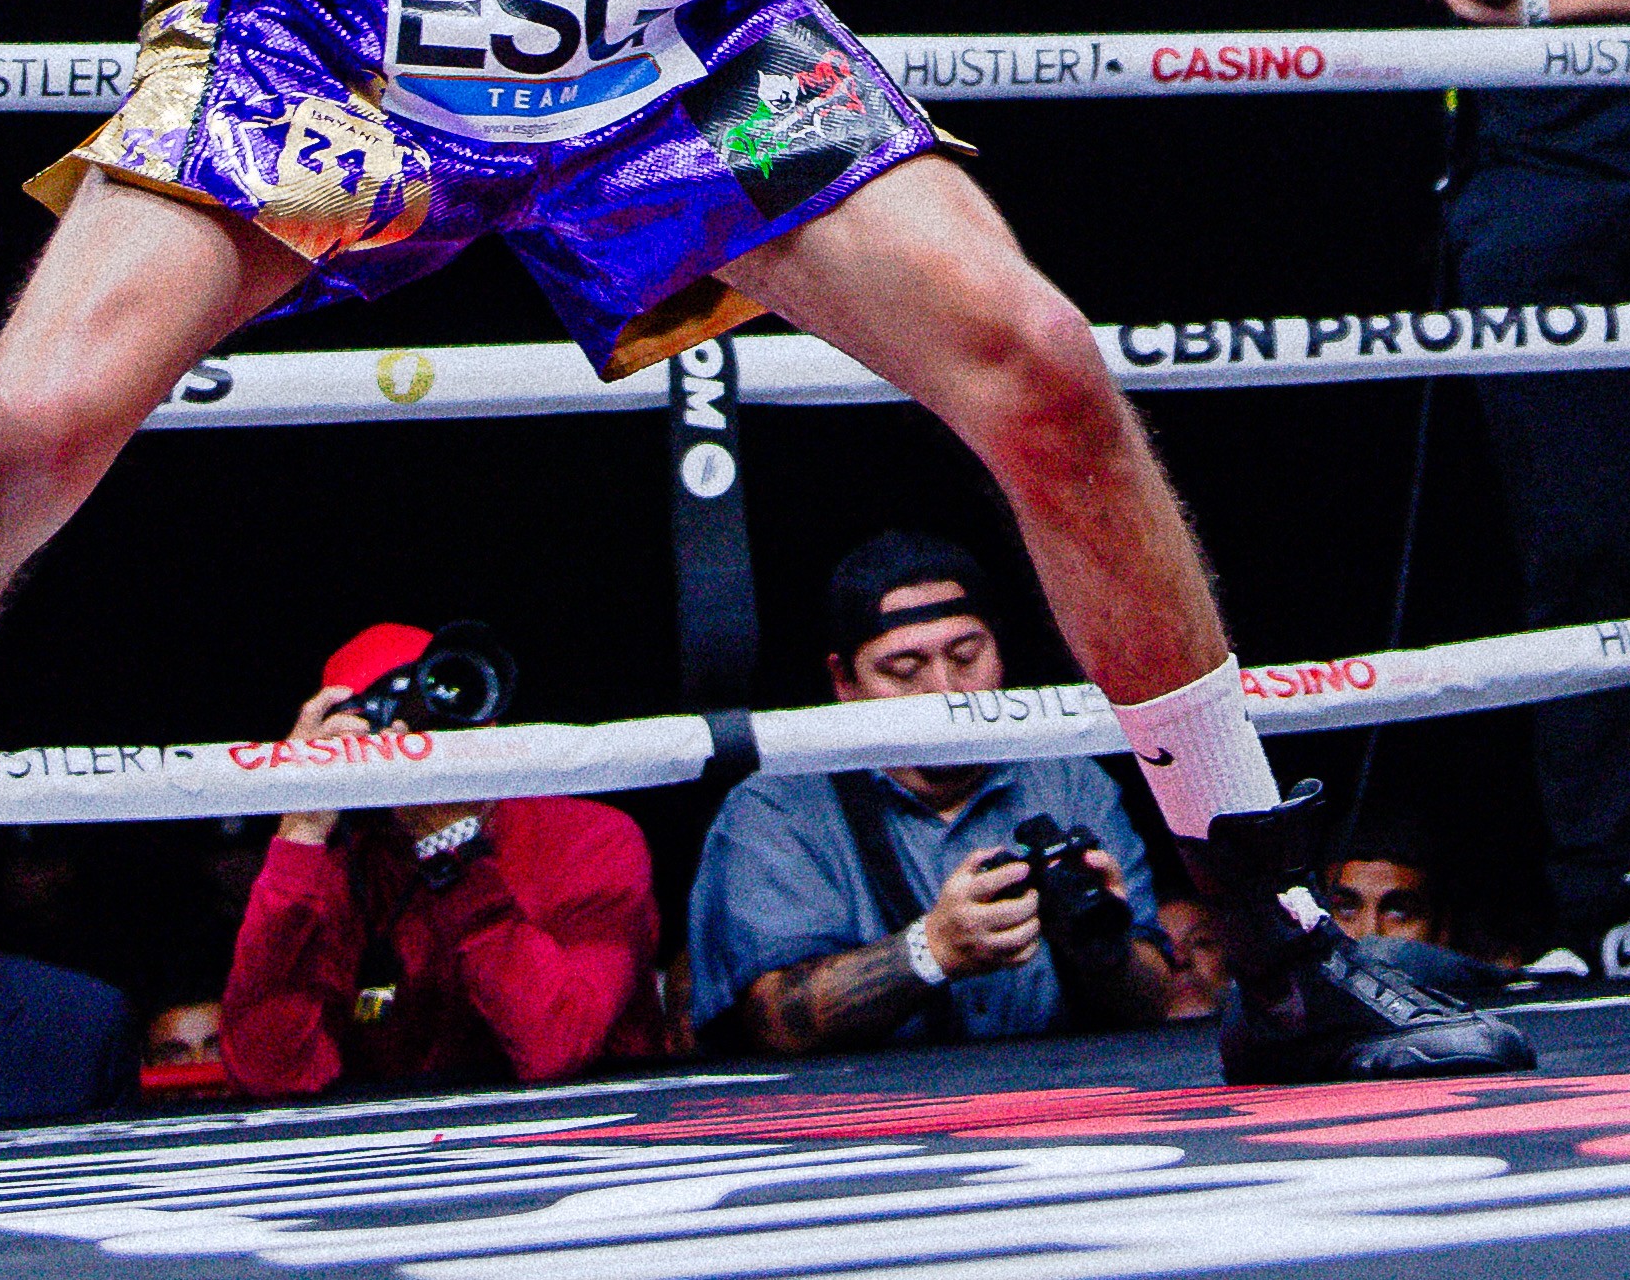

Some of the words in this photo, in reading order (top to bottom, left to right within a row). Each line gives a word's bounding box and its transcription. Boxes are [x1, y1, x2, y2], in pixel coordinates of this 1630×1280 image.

[902, 50, 1082, 86] HUSTLER
[1151, 45, 1326, 84] CASINO
[488, 84, 580, 109] TEAM
[312, 109, 382, 144] BRYANT
[1119, 321, 1274, 368] CBN
[944, 686, 1109, 723] HUSTLE
[1239, 658, 1378, 699] ASINO
[228, 731, 434, 770] CASINO
